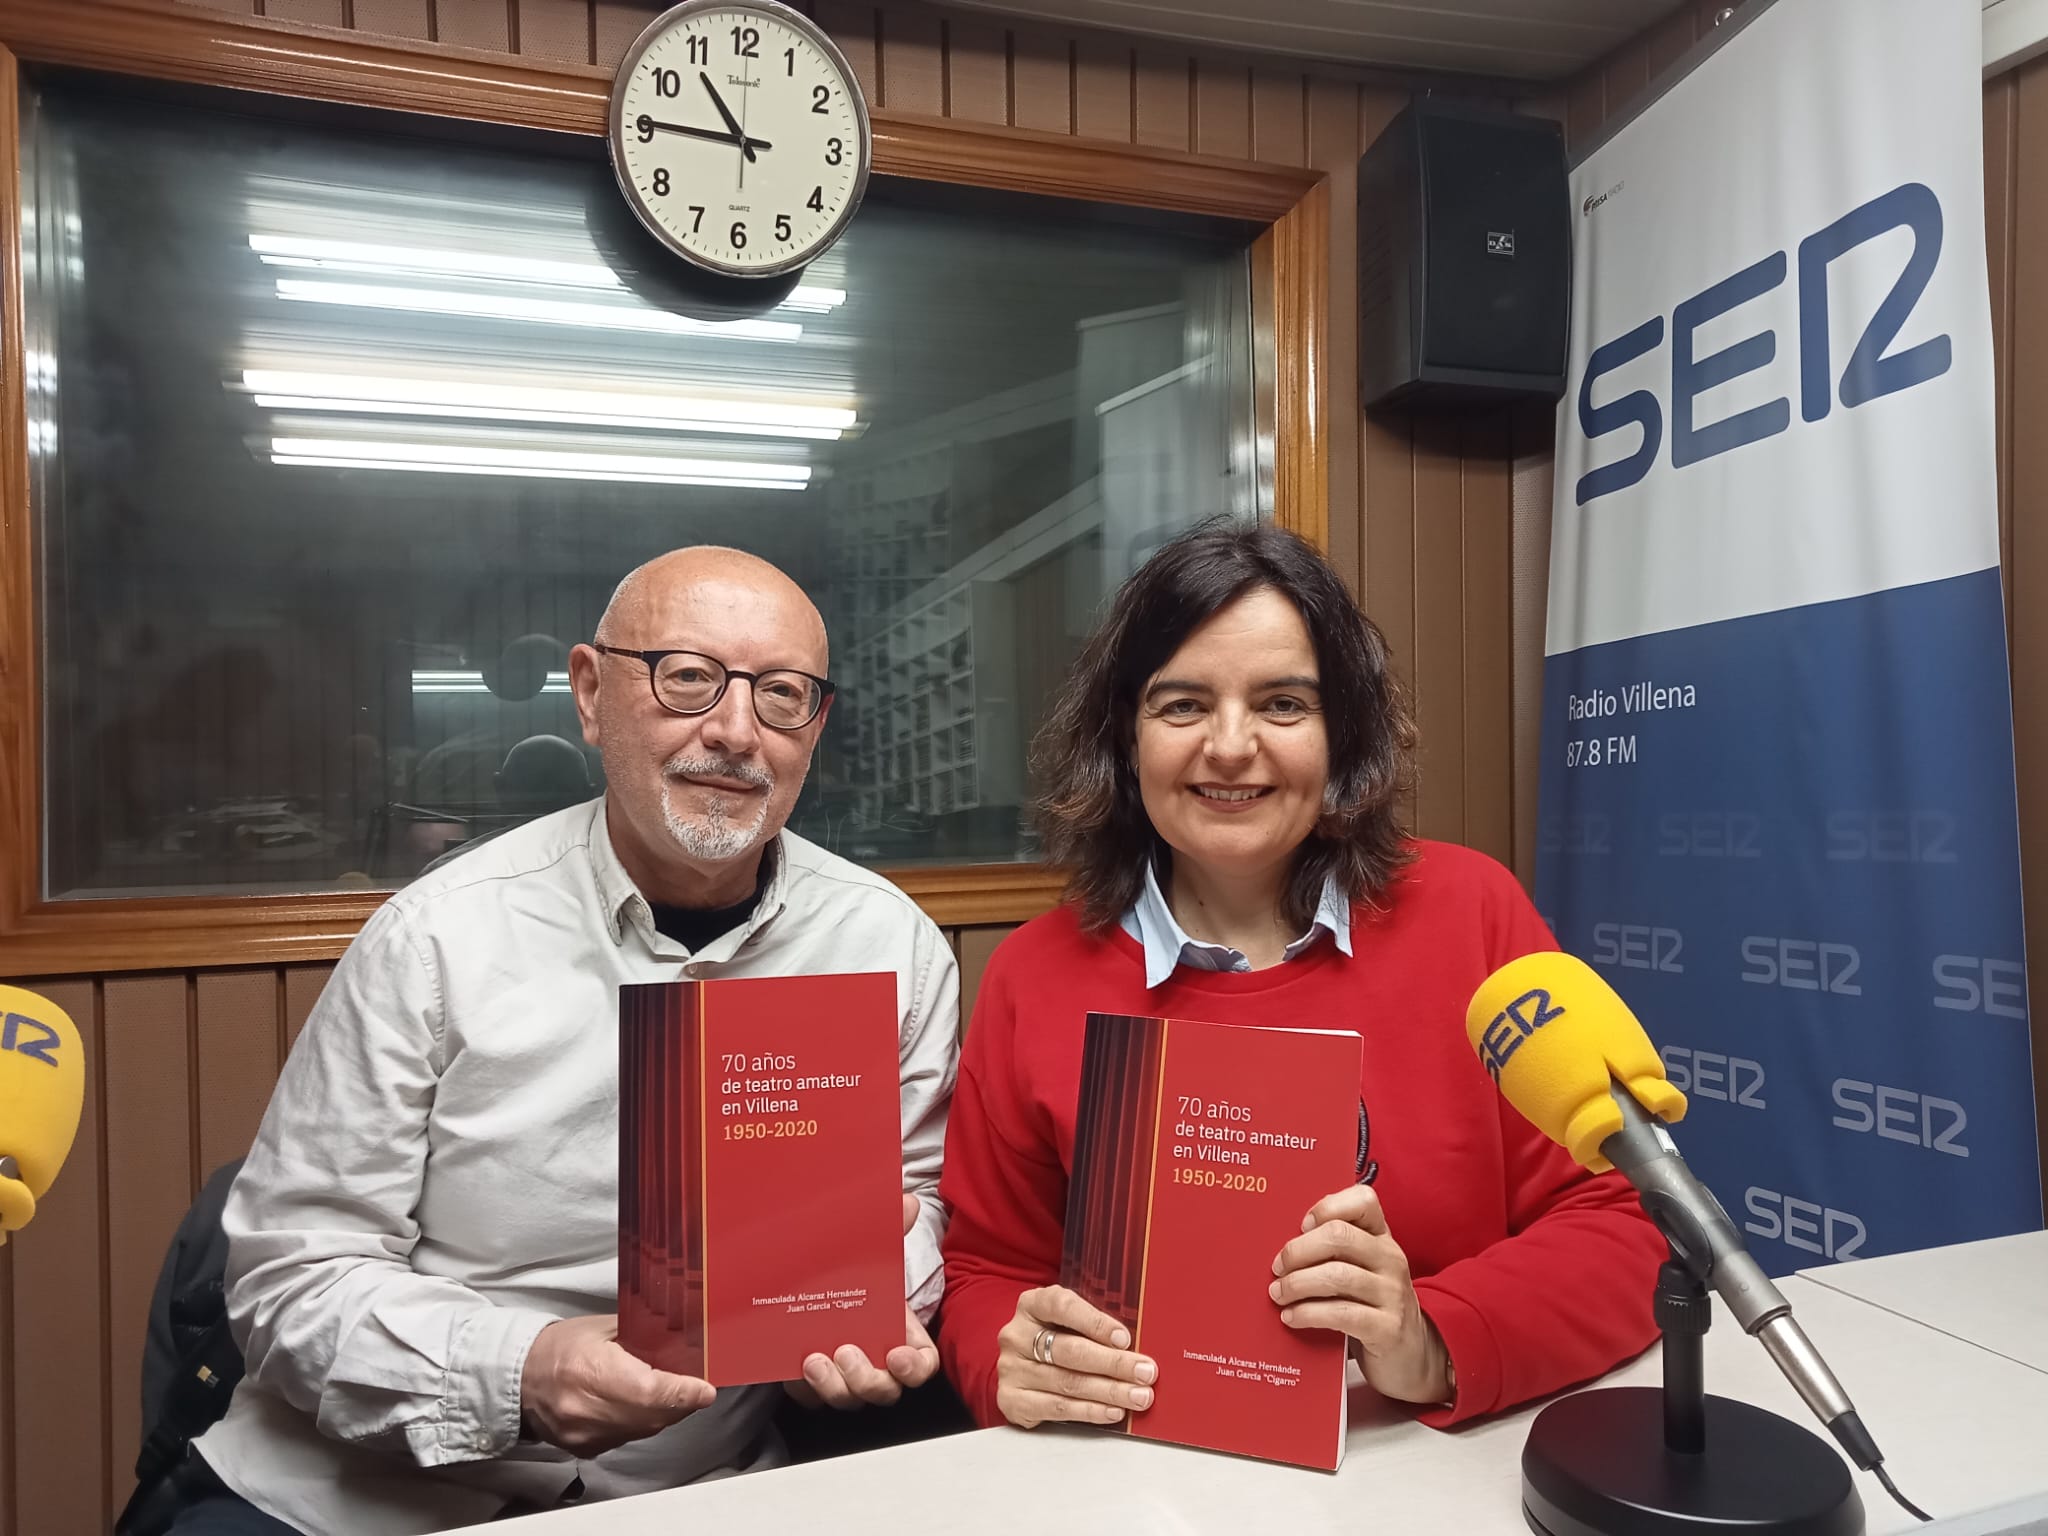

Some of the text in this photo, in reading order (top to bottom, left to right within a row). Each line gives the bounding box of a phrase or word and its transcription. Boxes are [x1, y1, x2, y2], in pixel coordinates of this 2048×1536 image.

[686, 35, 708, 66] 11
[730, 26, 760, 58] 12
[784, 47, 795, 77] 1
[651, 66, 681, 98] 10
[811, 85, 830, 114] 2
[637, 114, 654, 143] 9
[825, 138, 843, 166] 3
[652, 167, 671, 196] 8
[806, 186, 824, 213] 4
[688, 205, 705, 233] 7
[774, 213, 792, 241] 5
[730, 222, 747, 249] 6
[1576, 182, 1952, 507] SER
[1568, 681, 1696, 721] Radio Villena
[1567, 735, 1637, 767] 87.8 FM
[1543, 812, 1611, 855] SER
[1658, 812, 1762, 858] SER
[1825, 809, 1959, 864] SER
[1593, 922, 1685, 973] SER
[1741, 936, 1862, 996] SER
[0, 1011, 61, 1068] R
[721, 1052, 796, 1073] 70 años
[721, 1073, 862, 1094] de teatro amateur
[1661, 1045, 1766, 1110] SER
[721, 1097, 799, 1115] en Villena
[1178, 1096, 1252, 1122] 70 años
[1831, 1078, 1969, 1157] SER
[723, 1119, 818, 1141] 1950-2020
[1175, 1120, 1317, 1150] de teatro amateur
[1173, 1144, 1250, 1165] en Villena
[1173, 1167, 1267, 1193] 1950-2020
[1745, 1186, 1868, 1262] SER
[752, 1288, 867, 1306] Inmaculada Alcaraz Hernández
[786, 1303, 806, 1313] Juan
[806, 1302, 831, 1311] García
[1183, 1349, 1301, 1375] Inmaculada Alcaraz Hernández
[1216, 1367, 1235, 1377] Juan
[1236, 1370, 1262, 1381] García
